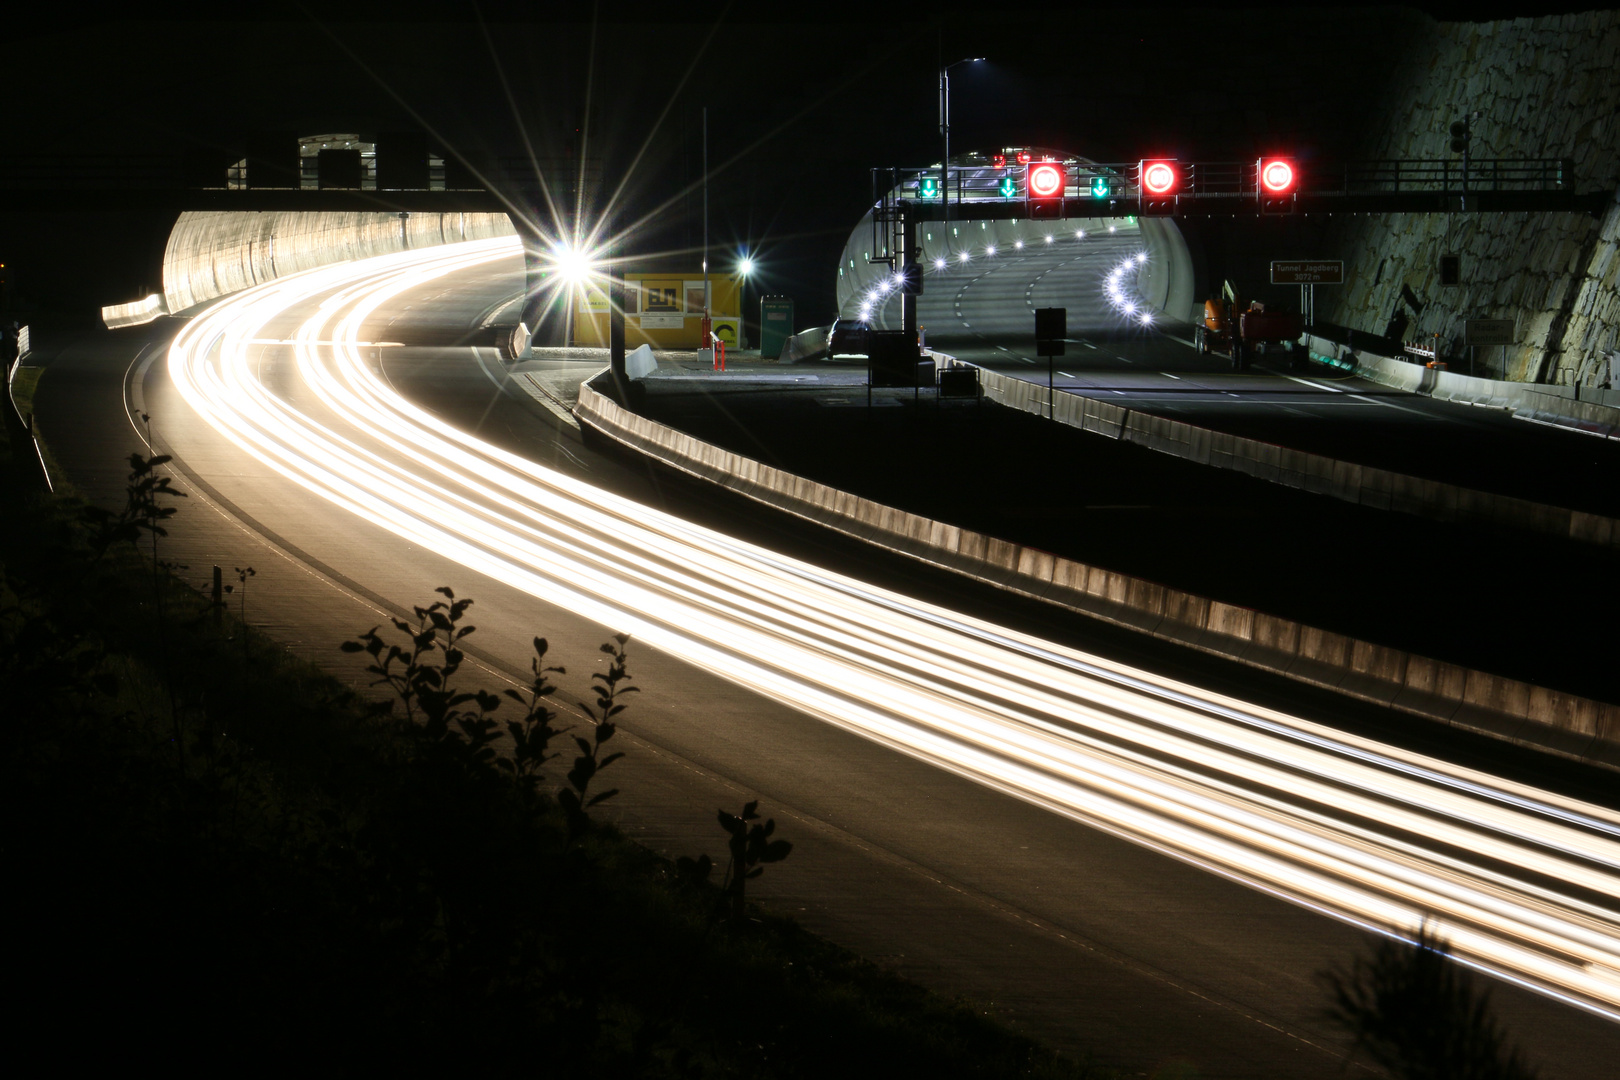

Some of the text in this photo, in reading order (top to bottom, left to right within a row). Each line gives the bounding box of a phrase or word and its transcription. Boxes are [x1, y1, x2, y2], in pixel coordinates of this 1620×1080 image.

[1277, 264, 1339, 273] Tunnel Jagdberg
[1474, 323, 1505, 332] Radar-
[1469, 334, 1509, 342] kontrolle
